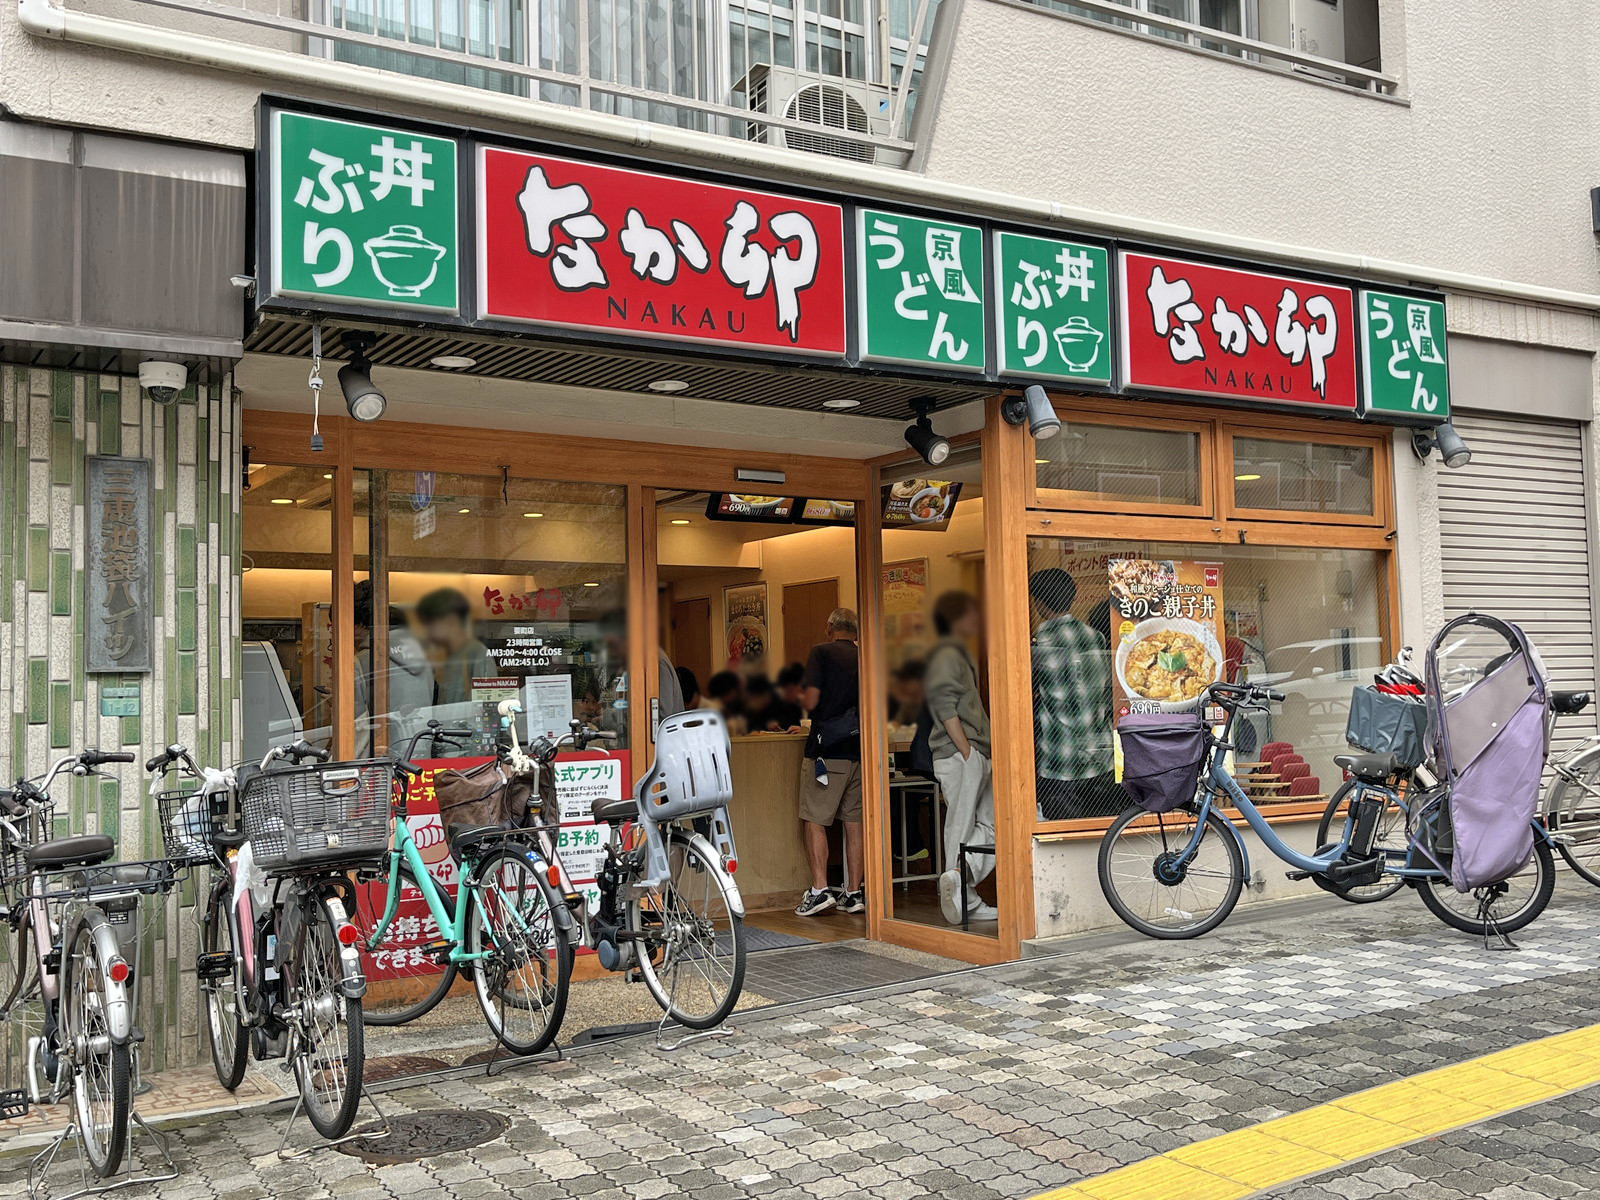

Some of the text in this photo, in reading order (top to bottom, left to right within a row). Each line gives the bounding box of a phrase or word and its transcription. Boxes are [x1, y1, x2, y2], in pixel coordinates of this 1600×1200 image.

[517, 164, 820, 341] なか卯
[868, 218, 969, 362] うどん
[608, 296, 747, 334] NAKAU
[1146, 265, 1338, 399] なか卯
[1204, 365, 1293, 394] NAKAU
[1369, 299, 1438, 412] うどん
[1119, 595, 1217, 618] きのこ親子丼
[539, 648, 562, 656] CLOSE
